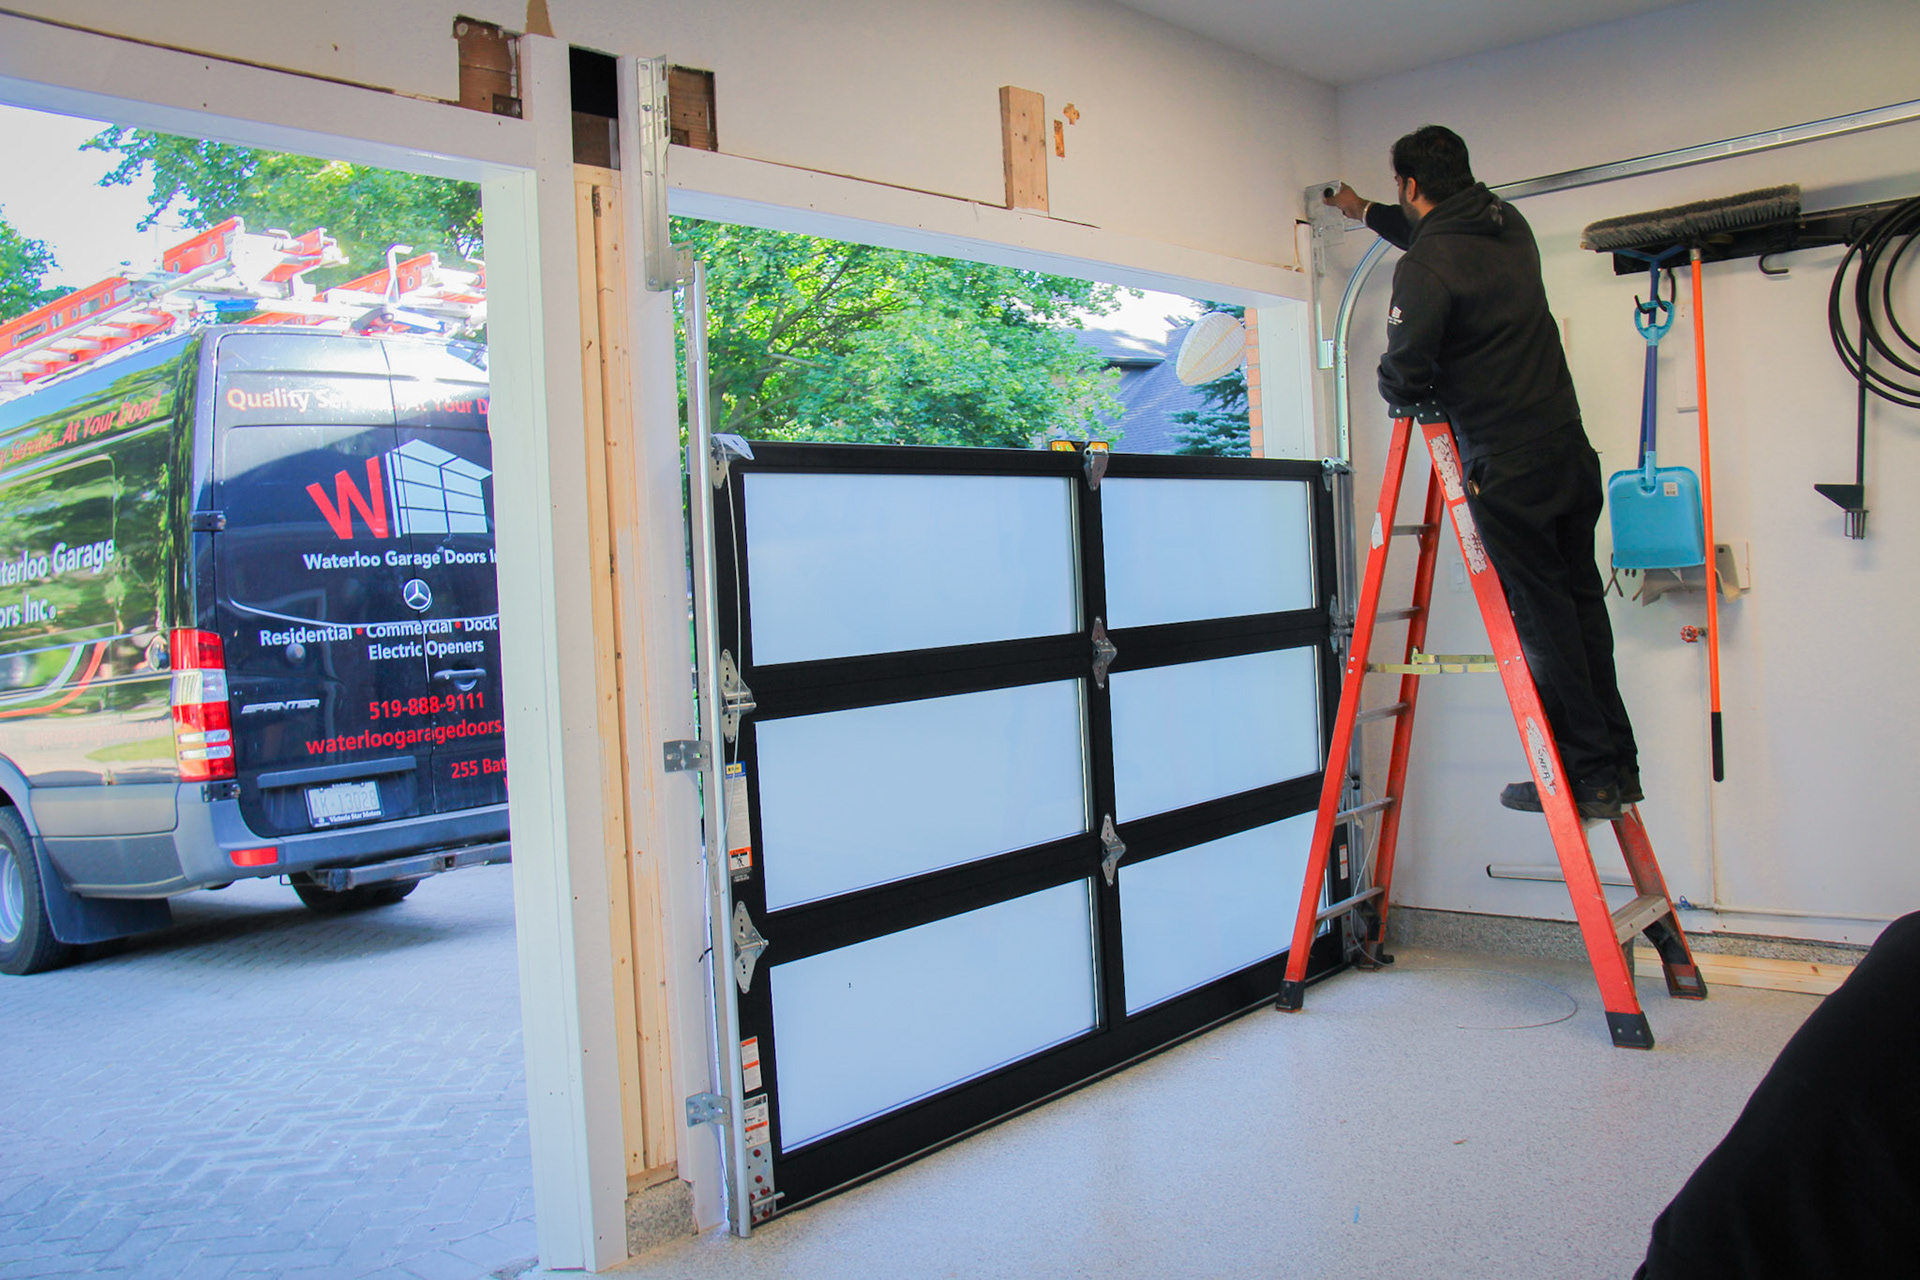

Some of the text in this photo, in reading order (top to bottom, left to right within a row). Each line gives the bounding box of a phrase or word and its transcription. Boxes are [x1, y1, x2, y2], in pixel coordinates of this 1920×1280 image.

[227, 387, 310, 412] Quality
[83, 410, 117, 438] Your
[116, 390, 162, 427] Door!
[306, 455, 389, 539] W
[52, 538, 116, 574] Garage
[302, 551, 381, 570] Waterloo
[385, 549, 440, 569] Garage
[445, 549, 487, 565] Doors
[259, 617, 498, 646] Residential Commercial Dock
[368, 639, 485, 660] Electric Openers
[241, 698, 320, 714] SPRINTER
[369, 691, 485, 720] 519-888-9111
[451, 760, 479, 779] 255
